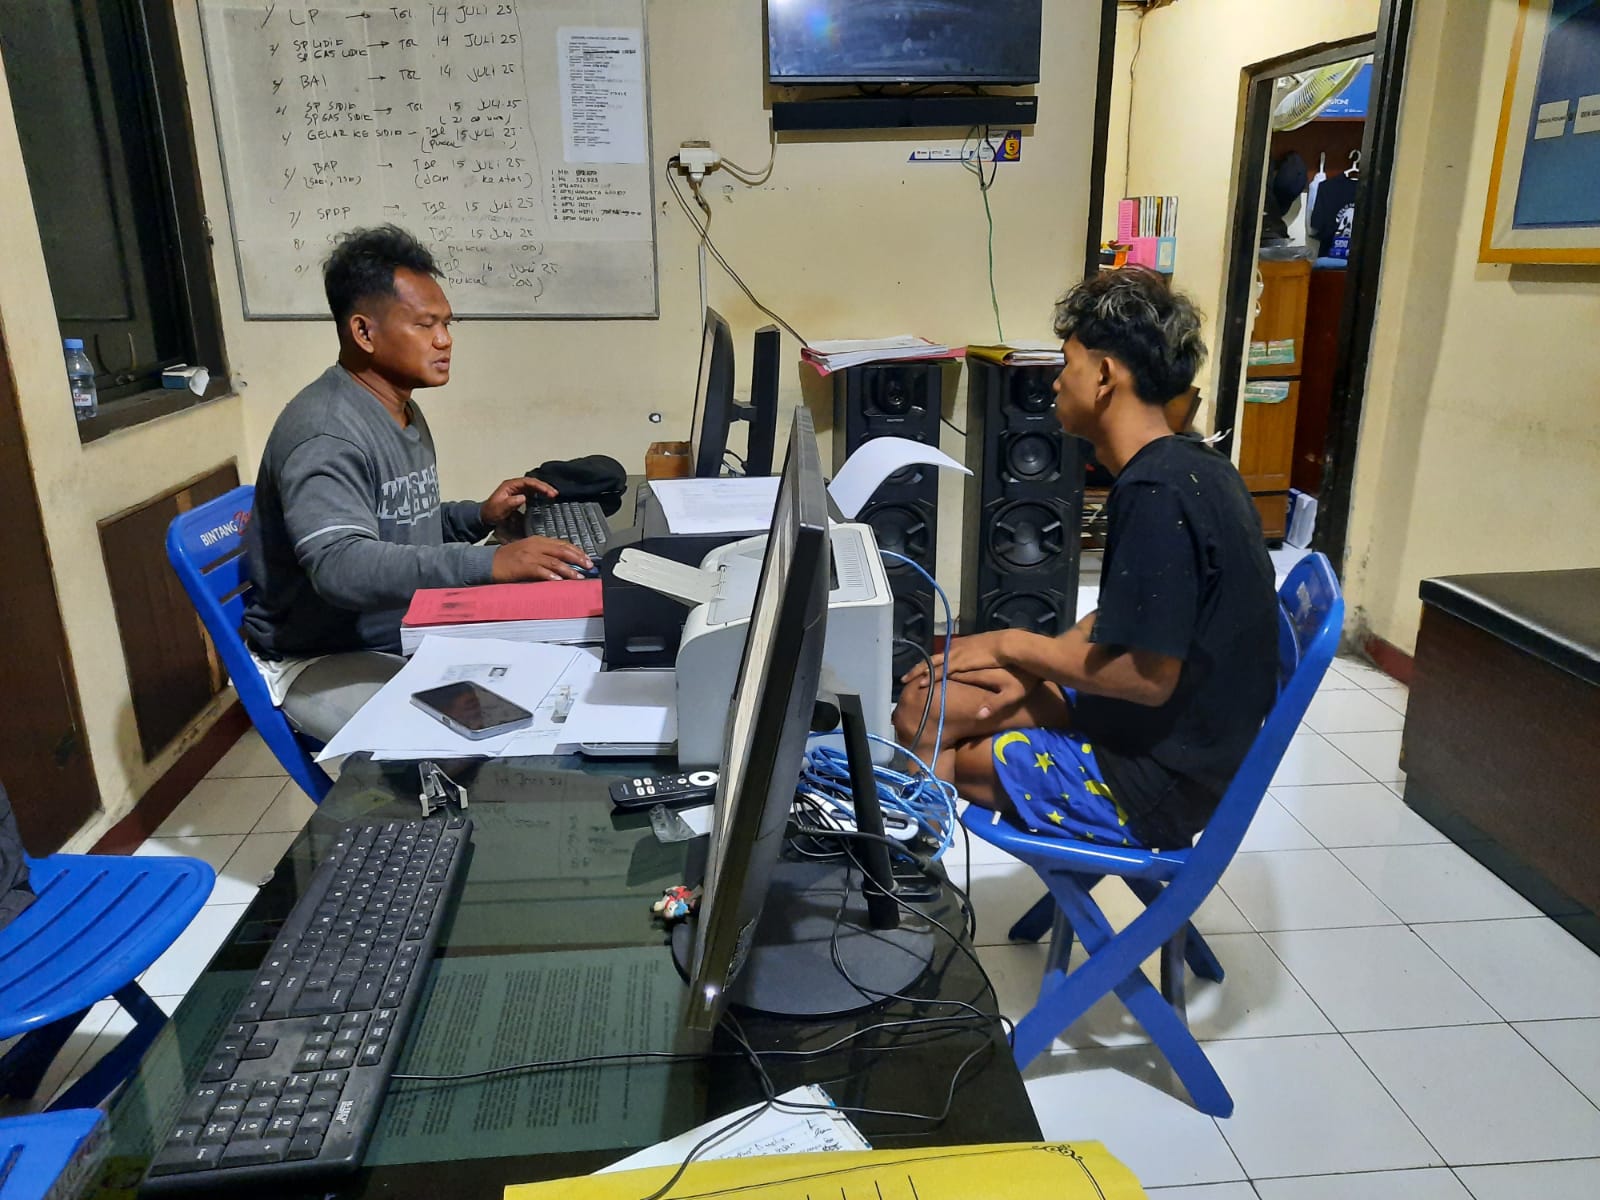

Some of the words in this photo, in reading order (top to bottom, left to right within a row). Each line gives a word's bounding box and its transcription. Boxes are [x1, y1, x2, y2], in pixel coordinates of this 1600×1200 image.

[431, 5, 448, 27] 14
[437, 34, 449, 47] 14
[463, 32, 495, 48] JULI
[500, 34, 518, 45] 25
[440, 63, 451, 79] 14
[316, 206, 351, 220] SPDP
[465, 201, 479, 212] 15
[471, 228, 485, 239] 15
[199, 520, 239, 547] BINTANG
